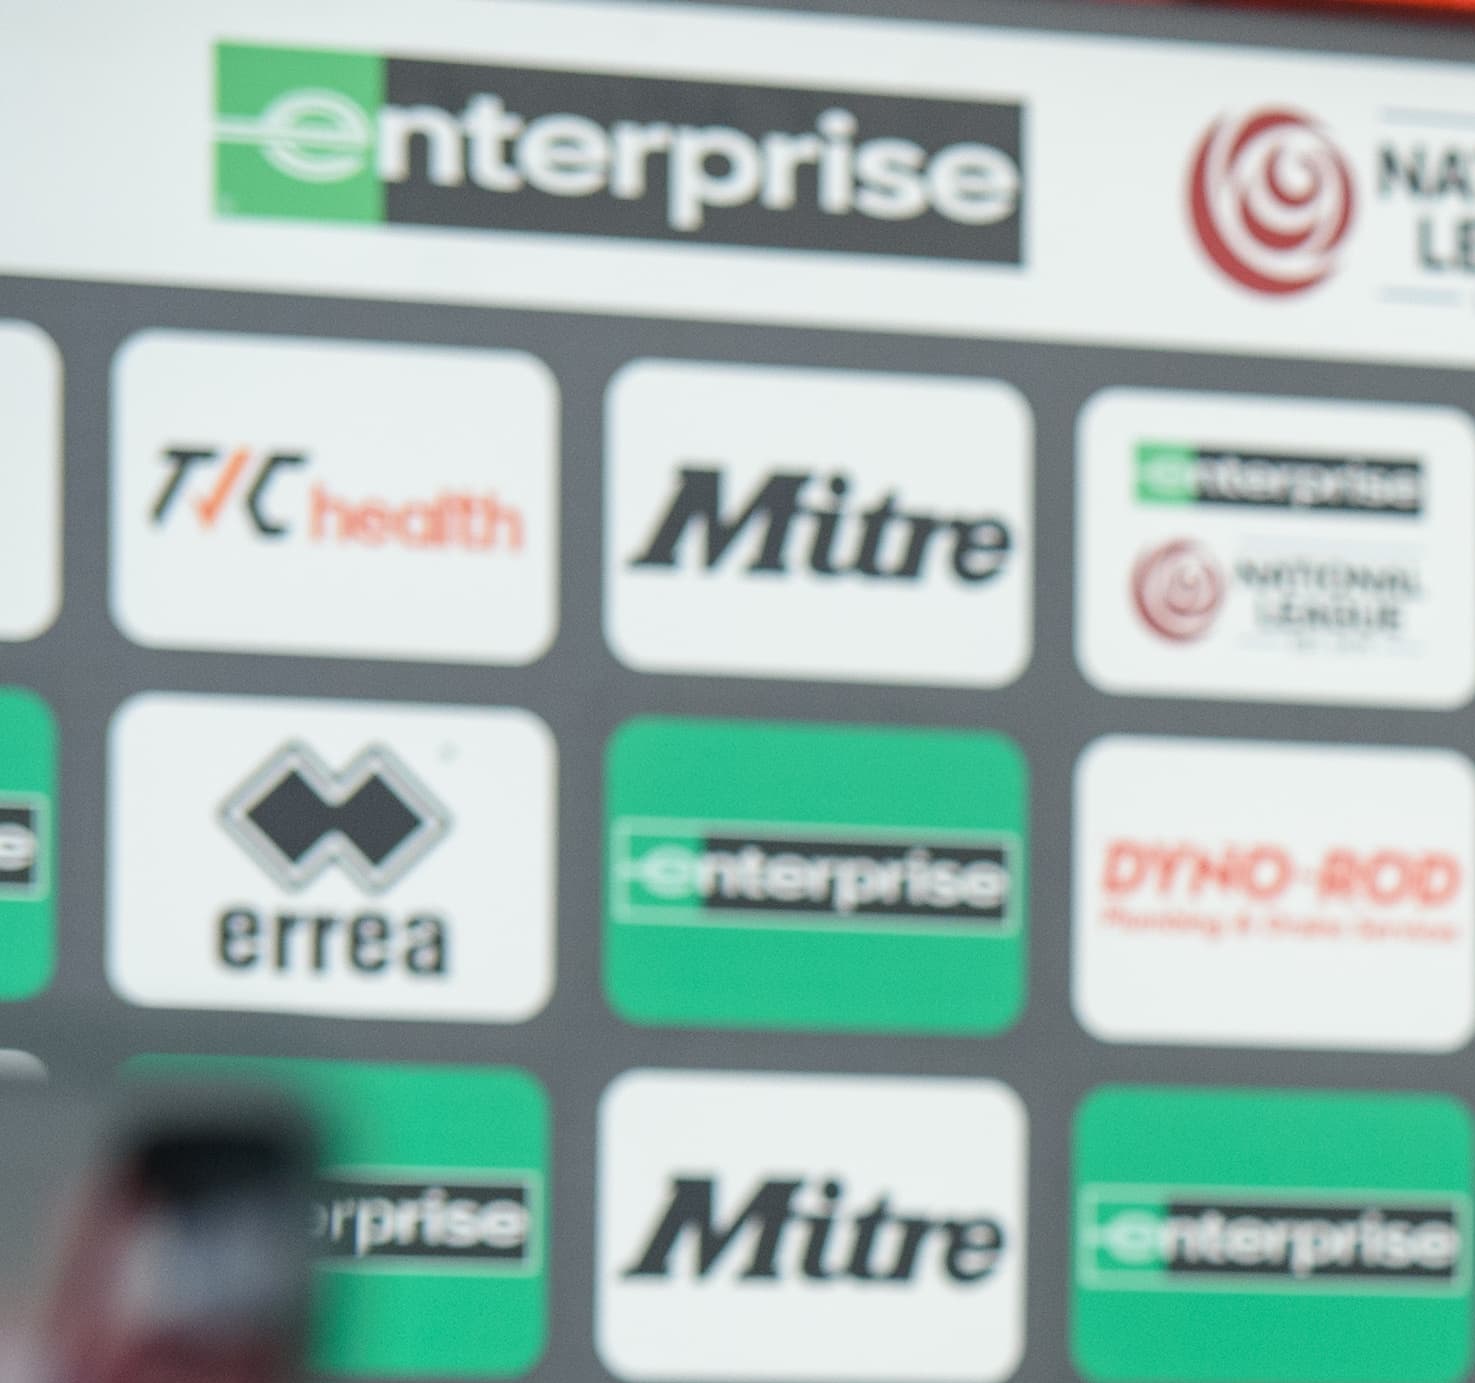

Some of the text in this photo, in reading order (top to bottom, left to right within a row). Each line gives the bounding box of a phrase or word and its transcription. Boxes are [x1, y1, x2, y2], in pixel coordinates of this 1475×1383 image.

[213, 86, 1022, 233] enterprise
[310, 481, 527, 554] health
[627, 466, 1012, 583] Mitre
[625, 843, 1010, 914] enterprise
[217, 906, 450, 976] errea
[620, 1176, 1005, 1284] Mitre
[1088, 1208, 1460, 1278] enterprise
